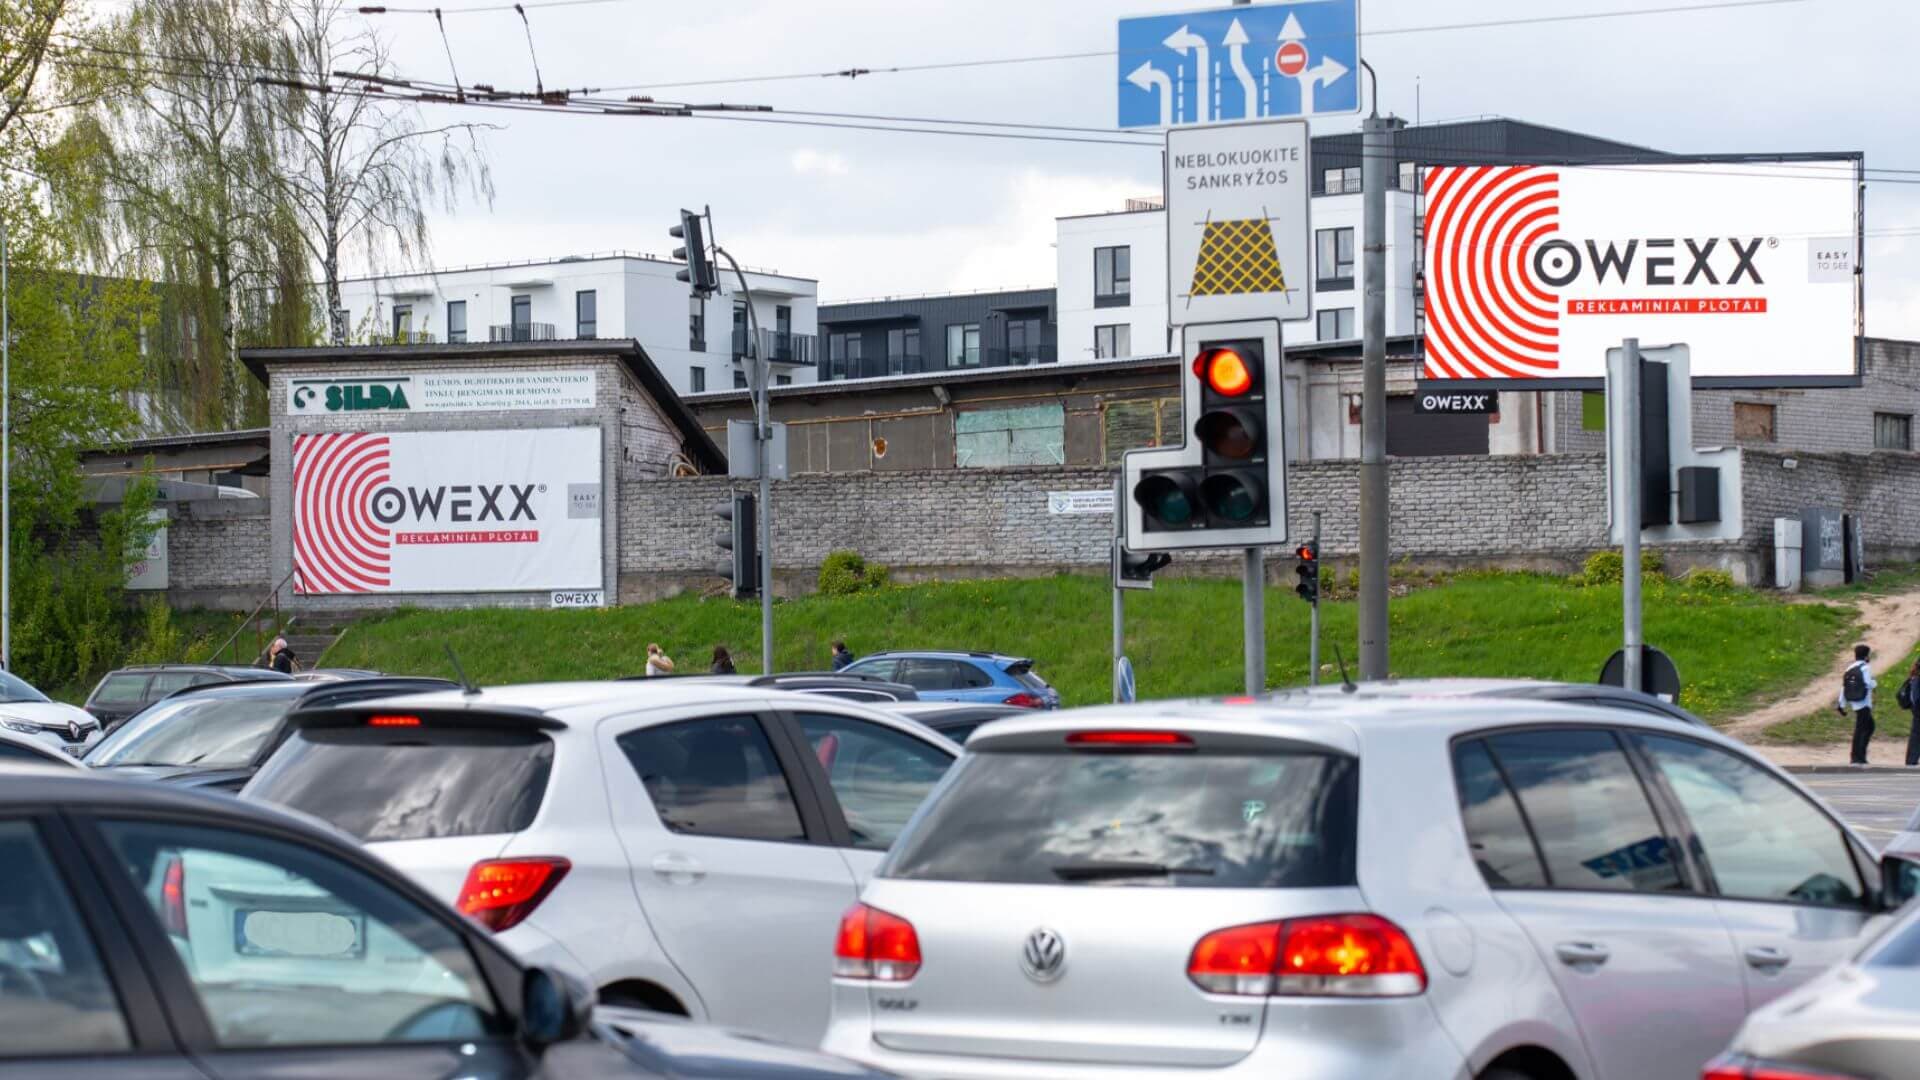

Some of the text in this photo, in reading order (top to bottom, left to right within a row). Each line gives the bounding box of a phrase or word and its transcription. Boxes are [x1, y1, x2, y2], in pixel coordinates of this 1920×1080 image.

[1175, 147, 1299, 169] NEBLOKUOKITE
[1187, 168, 1288, 190] SANKRYŽOS
[1817, 251, 1848, 260] EASY
[1818, 262, 1830, 270] TO
[1575, 299, 1760, 313] REKLAMINIAI PLOTAI
[401, 530, 534, 543] REKLAMINIAI PLOTAI
